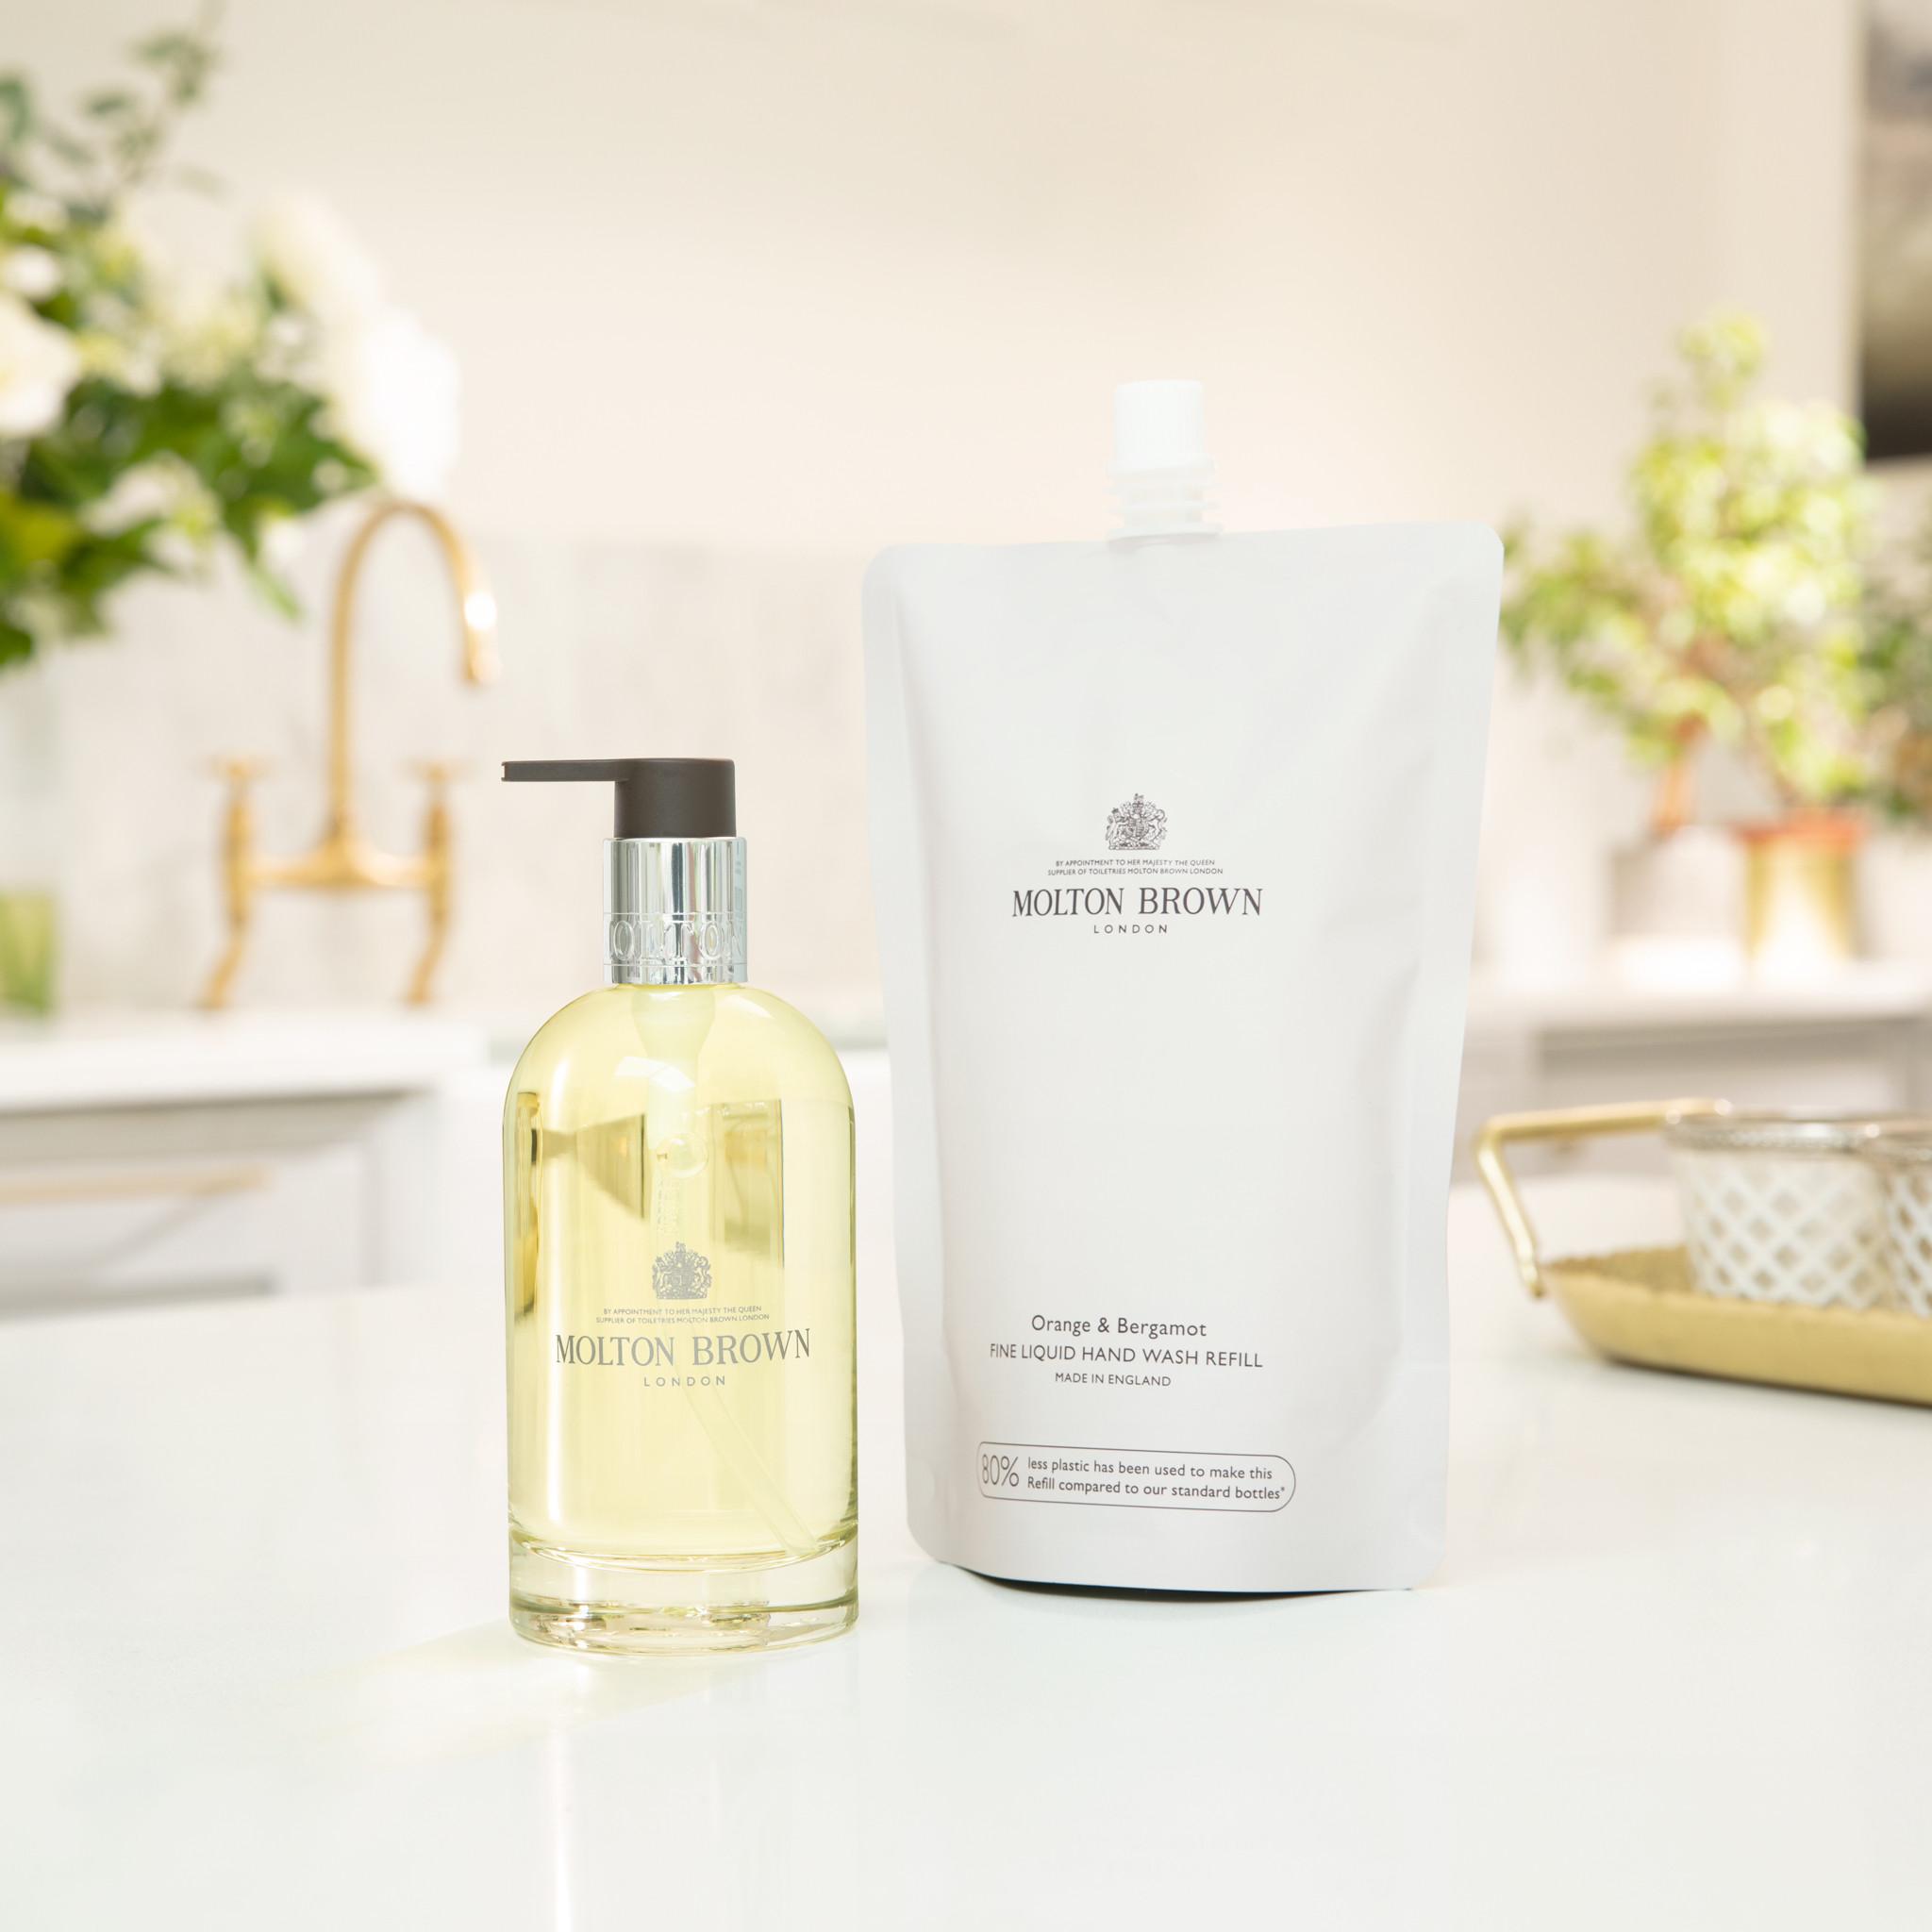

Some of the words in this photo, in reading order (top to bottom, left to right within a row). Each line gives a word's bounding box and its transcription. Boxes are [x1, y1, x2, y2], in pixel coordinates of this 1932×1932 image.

[1011, 888, 1124, 917] MOLTON
[1139, 887, 1263, 916] BROWN
[1093, 924, 1168, 934] LONDON
[1031, 1314, 1091, 1337] Orange
[1097, 1317, 1110, 1333] &
[1117, 1317, 1208, 1340] Bergamot
[556, 1334, 675, 1367] MOLTON
[691, 1327, 810, 1367] BROWN
[990, 1343, 1017, 1359] FINE
[1022, 1344, 1075, 1362] LIQUID
[1082, 1347, 1136, 1363] HAND
[1142, 1348, 1198, 1365] WASH
[1206, 1351, 1263, 1368] REFILL
[643, 1374, 725, 1388] LONDON
[1055, 1373, 1088, 1383] MADE
[1091, 1374, 1105, 1384] IN
[1108, 1374, 1172, 1387] ENGLAND
[981, 1454, 1020, 1487] 80%
[1027, 1457, 1048, 1471] less
[1051, 1457, 1091, 1476] plastic
[1093, 1459, 1115, 1474] has
[1118, 1460, 1150, 1475] been
[1154, 1462, 1186, 1477] used
[1190, 1465, 1206, 1478] to
[1209, 1464, 1245, 1479] make
[1249, 1465, 1273, 1480] this
[1027, 1475, 1055, 1491] Refill
[1058, 1478, 1122, 1497] compared
[1124, 1481, 1140, 1494] to
[1142, 1484, 1167, 1495] our
[1171, 1483, 1231, 1499] standard
